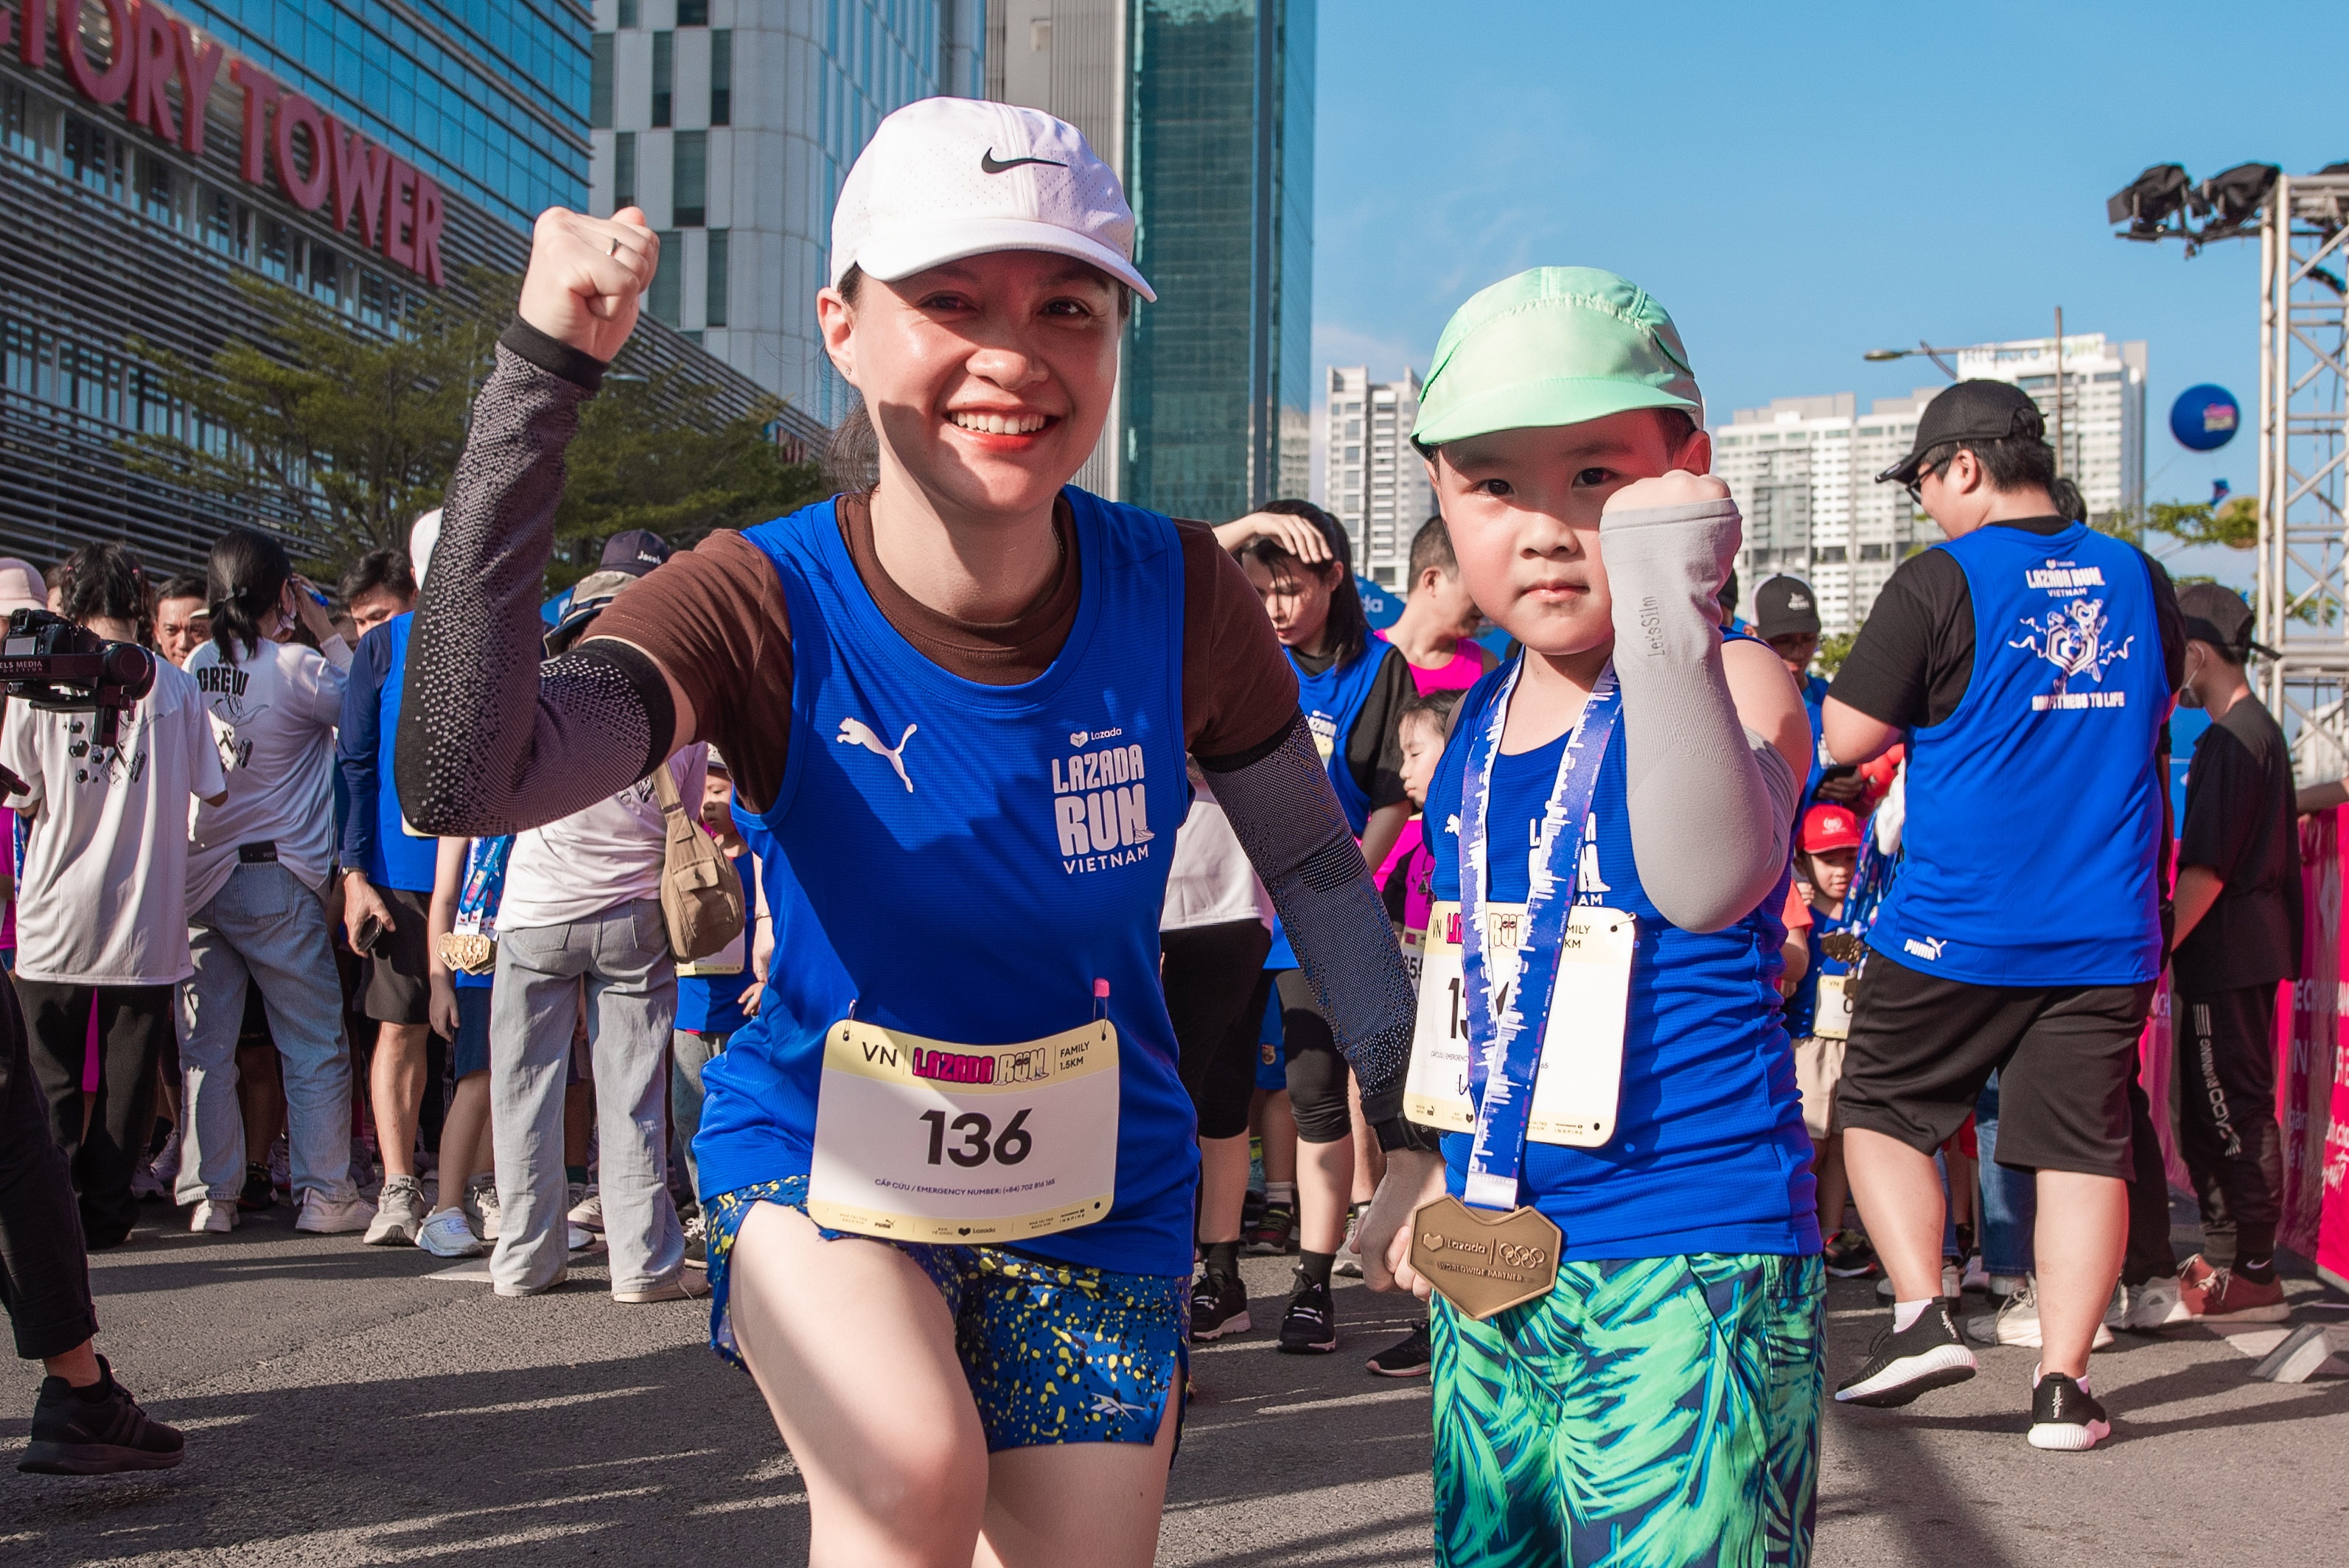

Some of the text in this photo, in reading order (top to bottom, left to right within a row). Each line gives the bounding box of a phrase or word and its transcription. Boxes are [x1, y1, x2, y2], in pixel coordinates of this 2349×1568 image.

[0, 0, 444, 287] TORY TOWER
[637, 550, 662, 565] Jacob
[2025, 569, 2072, 589] LAZADA
[2047, 587, 2087, 598] VIETNAM
[197, 666, 250, 697] CREW
[1090, 727, 1123, 741] Lazada
[1052, 744, 1145, 794] LAZADA
[1054, 783, 1150, 857] RUN
[1063, 844, 1149, 875] VIETNAM
[1432, 919, 1442, 939] VN
[1904, 938, 1936, 962] PUMA
[862, 1040, 1091, 1085] VN LAZADA RUN FAMILY
[1059, 1056, 1084, 1071] 1.5KM
[918, 1107, 1033, 1168] 136
[911, 1184, 916, 1192] /
[917, 1185, 966, 1196] EMERGENCY
[967, 1187, 1002, 1196] NUMBER:
[1002, 1184, 1020, 1194] (+84)
[1021, 1183, 1034, 1192] 702
[1034, 1181, 1044, 1189] 816
[1447, 1237, 1487, 1253] Lazada
[1438, 1261, 1523, 1282] WORLDWIDE PARTNER
